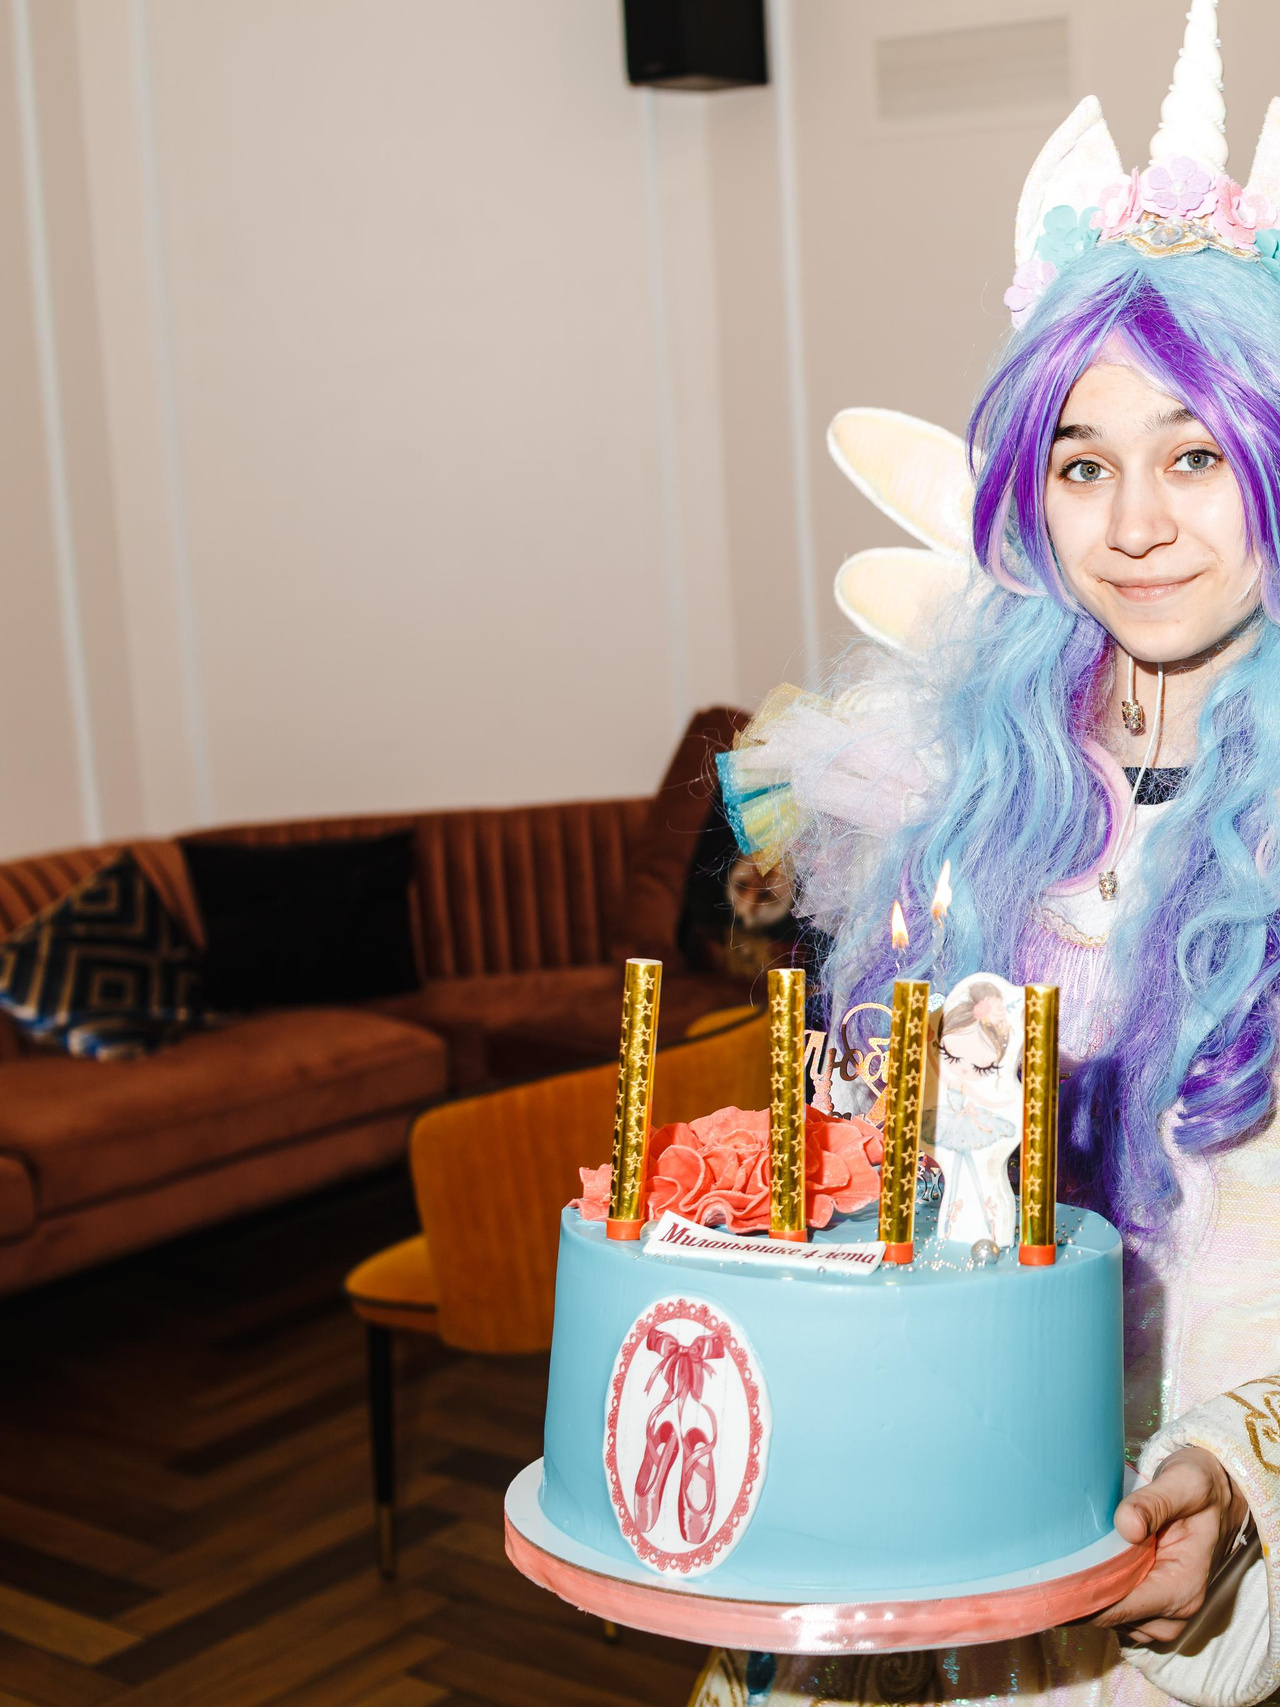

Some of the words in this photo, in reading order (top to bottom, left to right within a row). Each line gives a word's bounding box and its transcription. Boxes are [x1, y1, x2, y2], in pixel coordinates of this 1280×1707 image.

[659, 1221, 802, 1256] Миланьюшке
[802, 1249, 819, 1259] 4
[818, 1251, 877, 1265] лета
